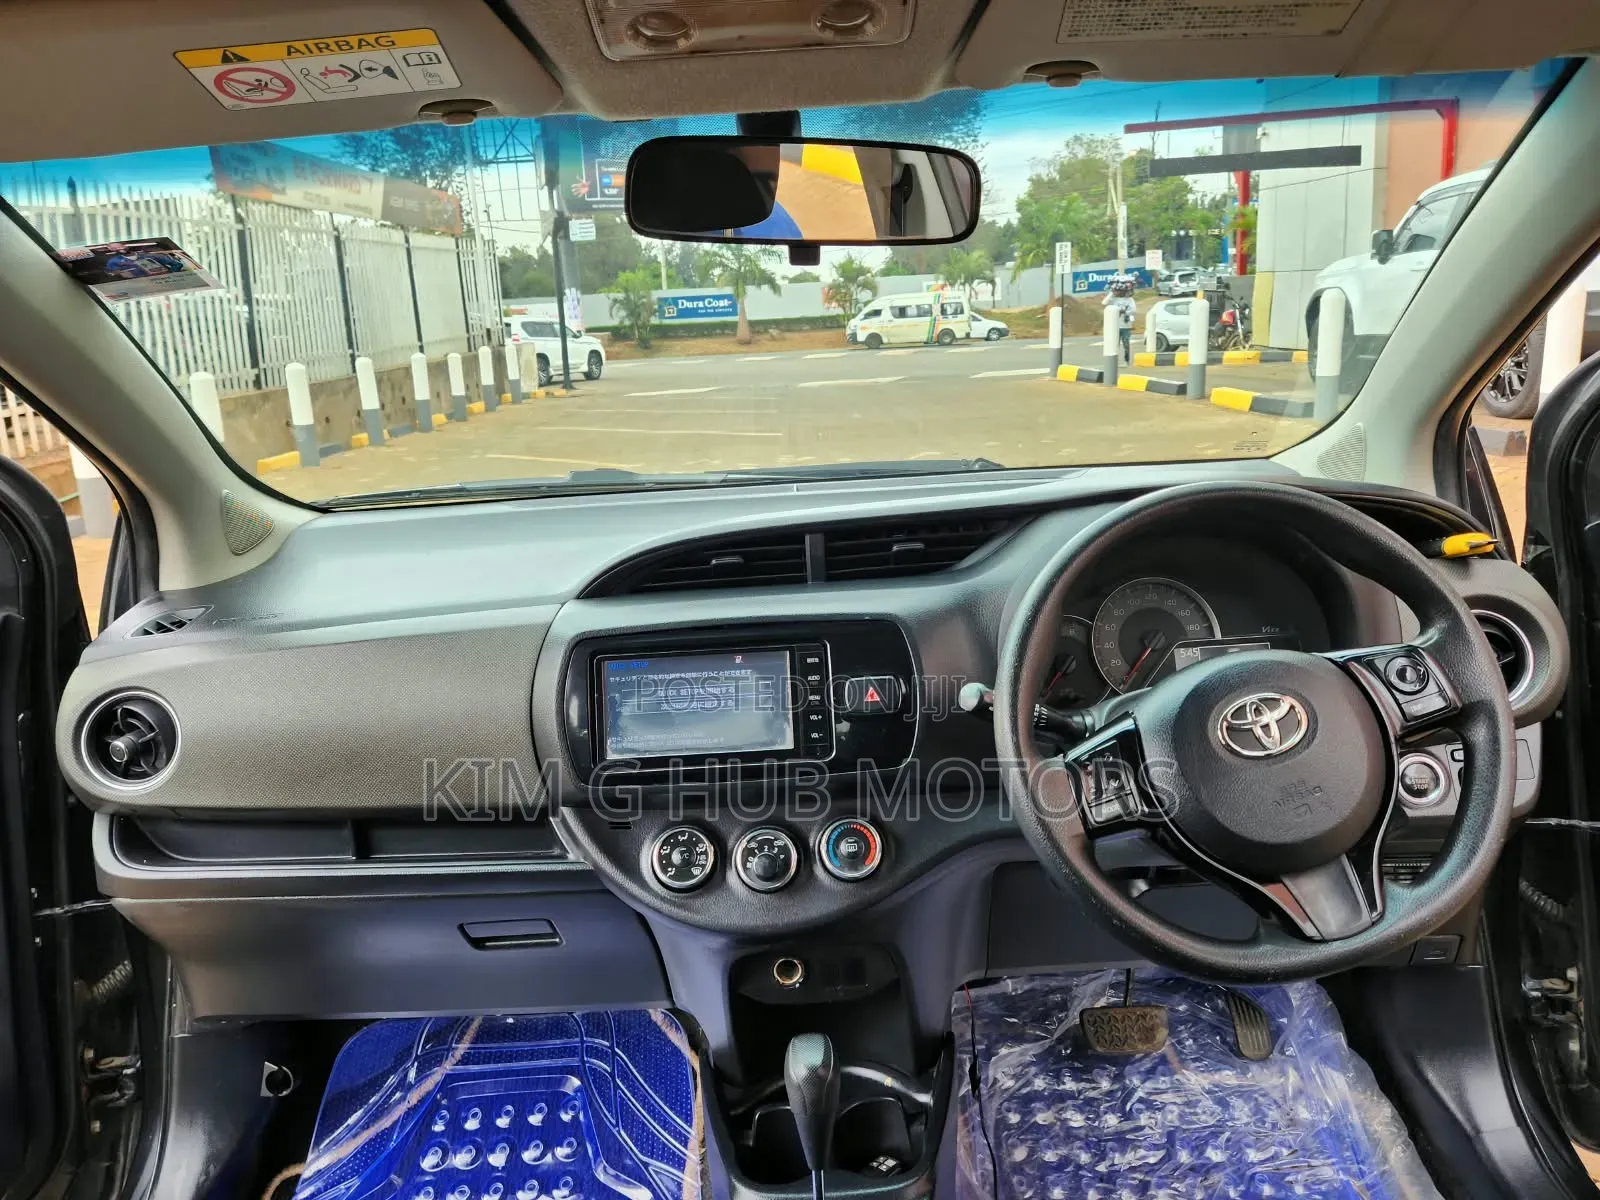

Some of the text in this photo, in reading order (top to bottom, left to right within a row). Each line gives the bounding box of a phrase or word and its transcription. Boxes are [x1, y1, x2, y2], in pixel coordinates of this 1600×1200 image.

[286, 35, 397, 57] AIRBAG
[1113, 608, 1125, 616] 80
[1177, 609, 1191, 617] 160
[1105, 623, 1116, 631] 60
[1187, 623, 1200, 631] 180
[1103, 641, 1115, 649] 40
[1110, 658, 1121, 667] 20
